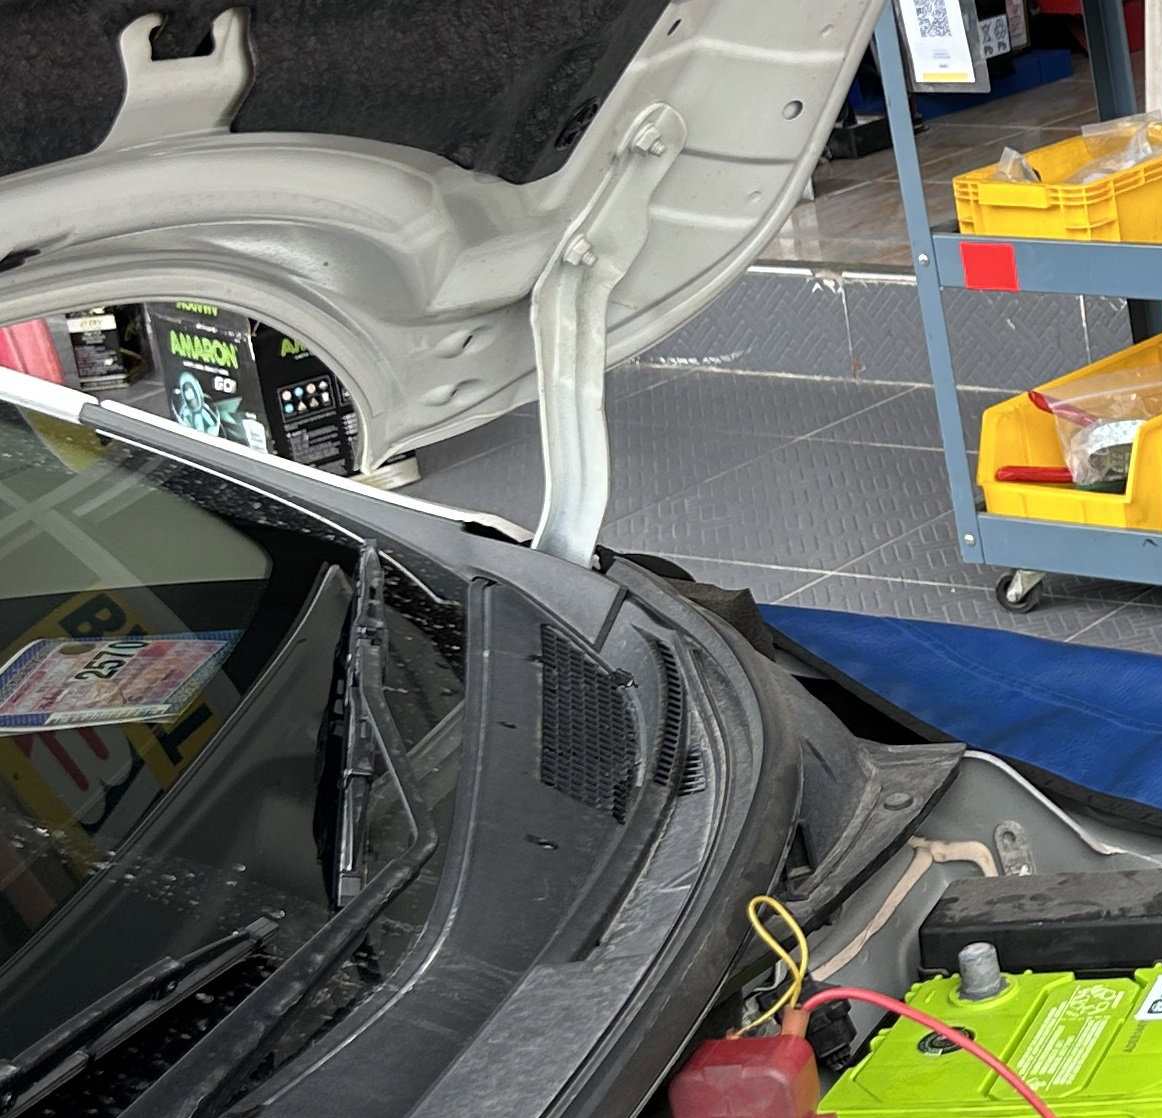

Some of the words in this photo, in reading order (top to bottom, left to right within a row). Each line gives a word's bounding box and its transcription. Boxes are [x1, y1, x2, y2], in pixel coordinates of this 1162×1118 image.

[170, 329, 239, 369] AMARON
[214, 376, 237, 393] GO
[75, 641, 151, 680] 2570
